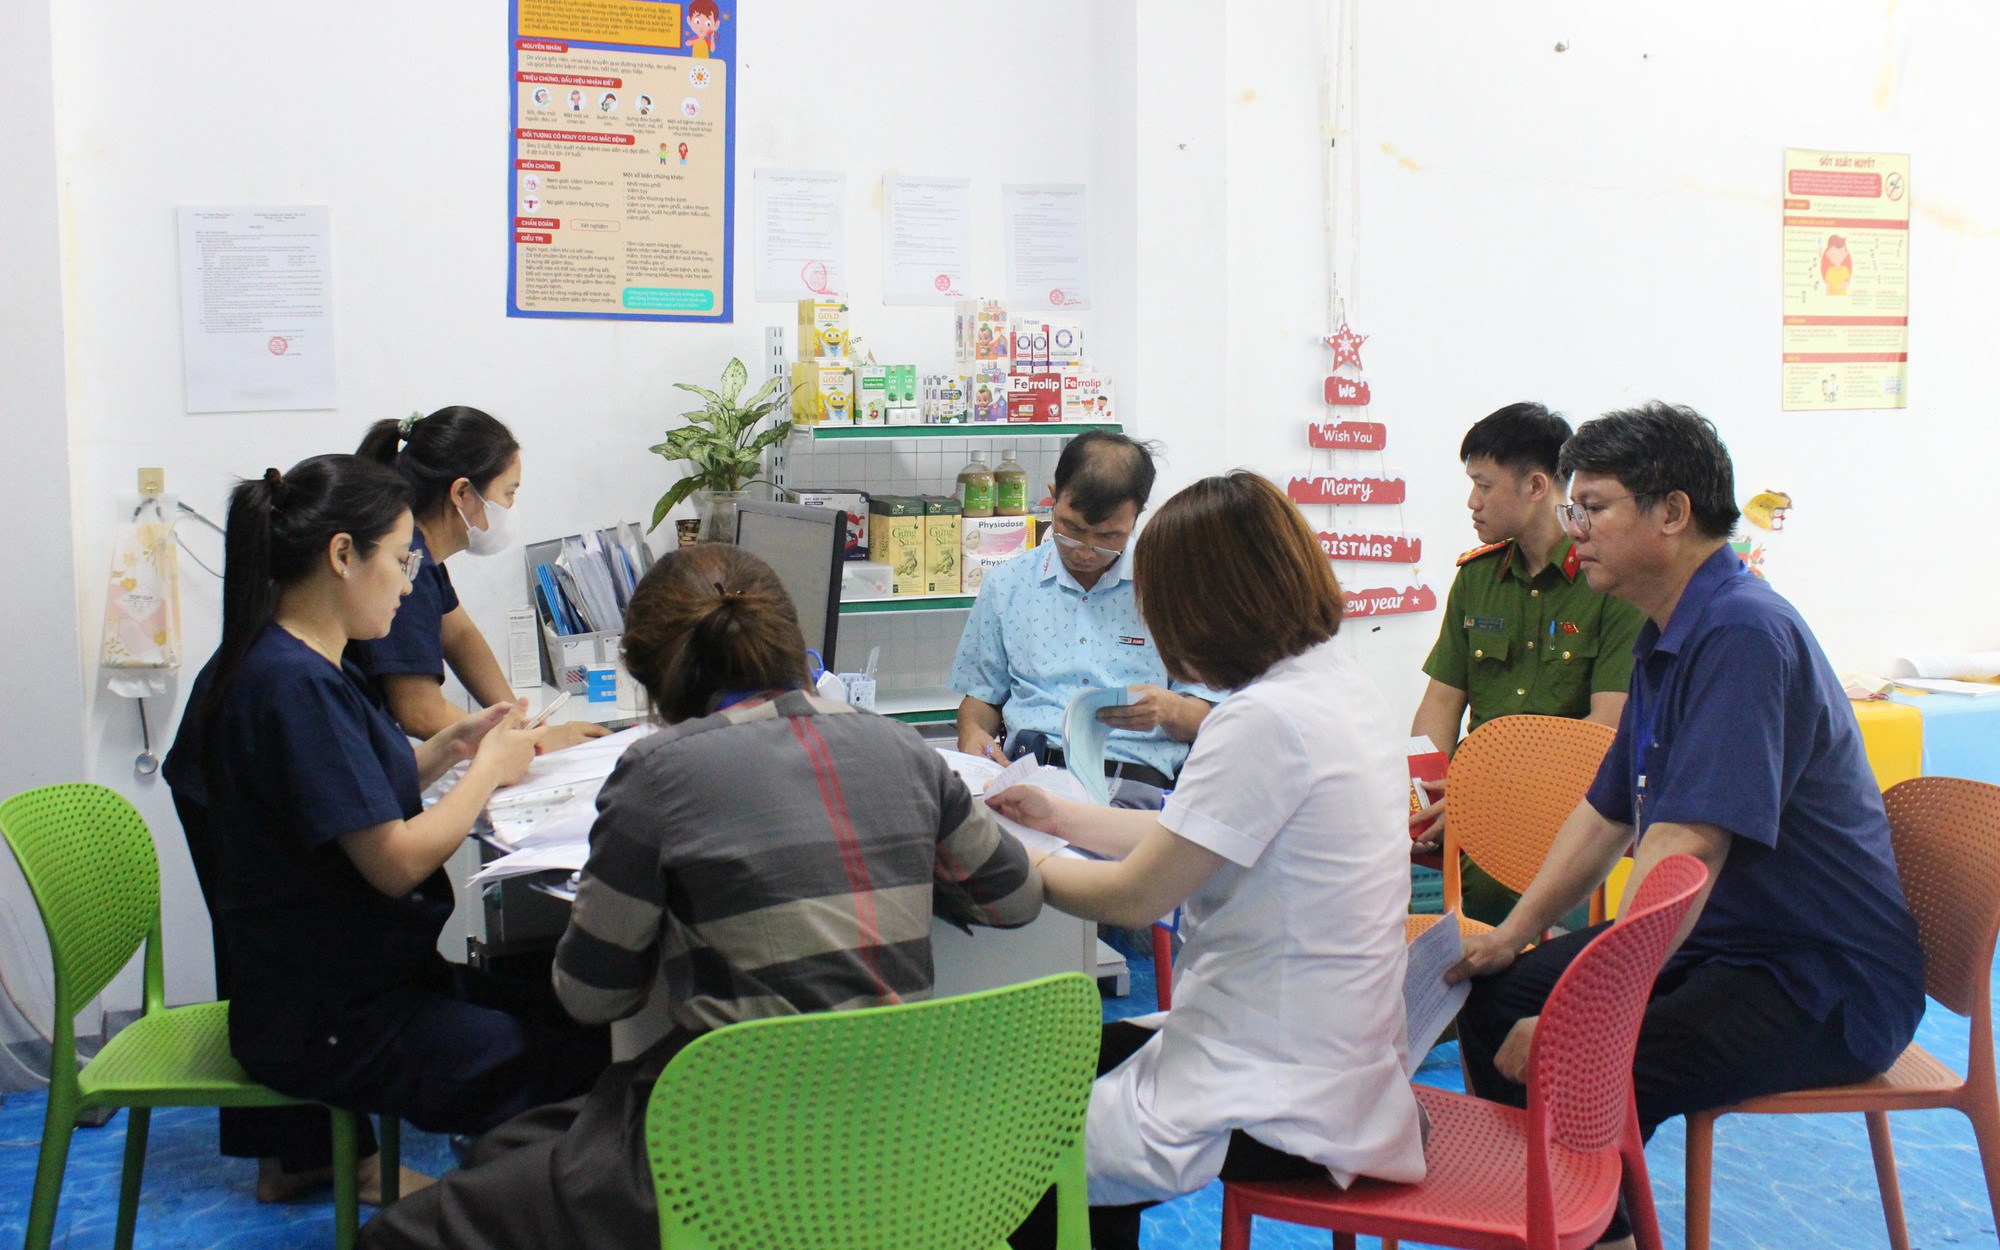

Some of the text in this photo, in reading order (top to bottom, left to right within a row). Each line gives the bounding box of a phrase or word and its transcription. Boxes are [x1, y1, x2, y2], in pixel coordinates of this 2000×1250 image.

[1014, 378, 1060, 391] Ferrolip
[1066, 378, 1102, 389] Ferrolip
[1338, 384, 1356, 398] We
[1324, 430, 1372, 443] Wish You
[1321, 478, 1373, 502] Merry
[978, 520, 1024, 530] Physiodose
[1319, 540, 1392, 557] RISTMAS
[1343, 596, 1404, 614] ew year
